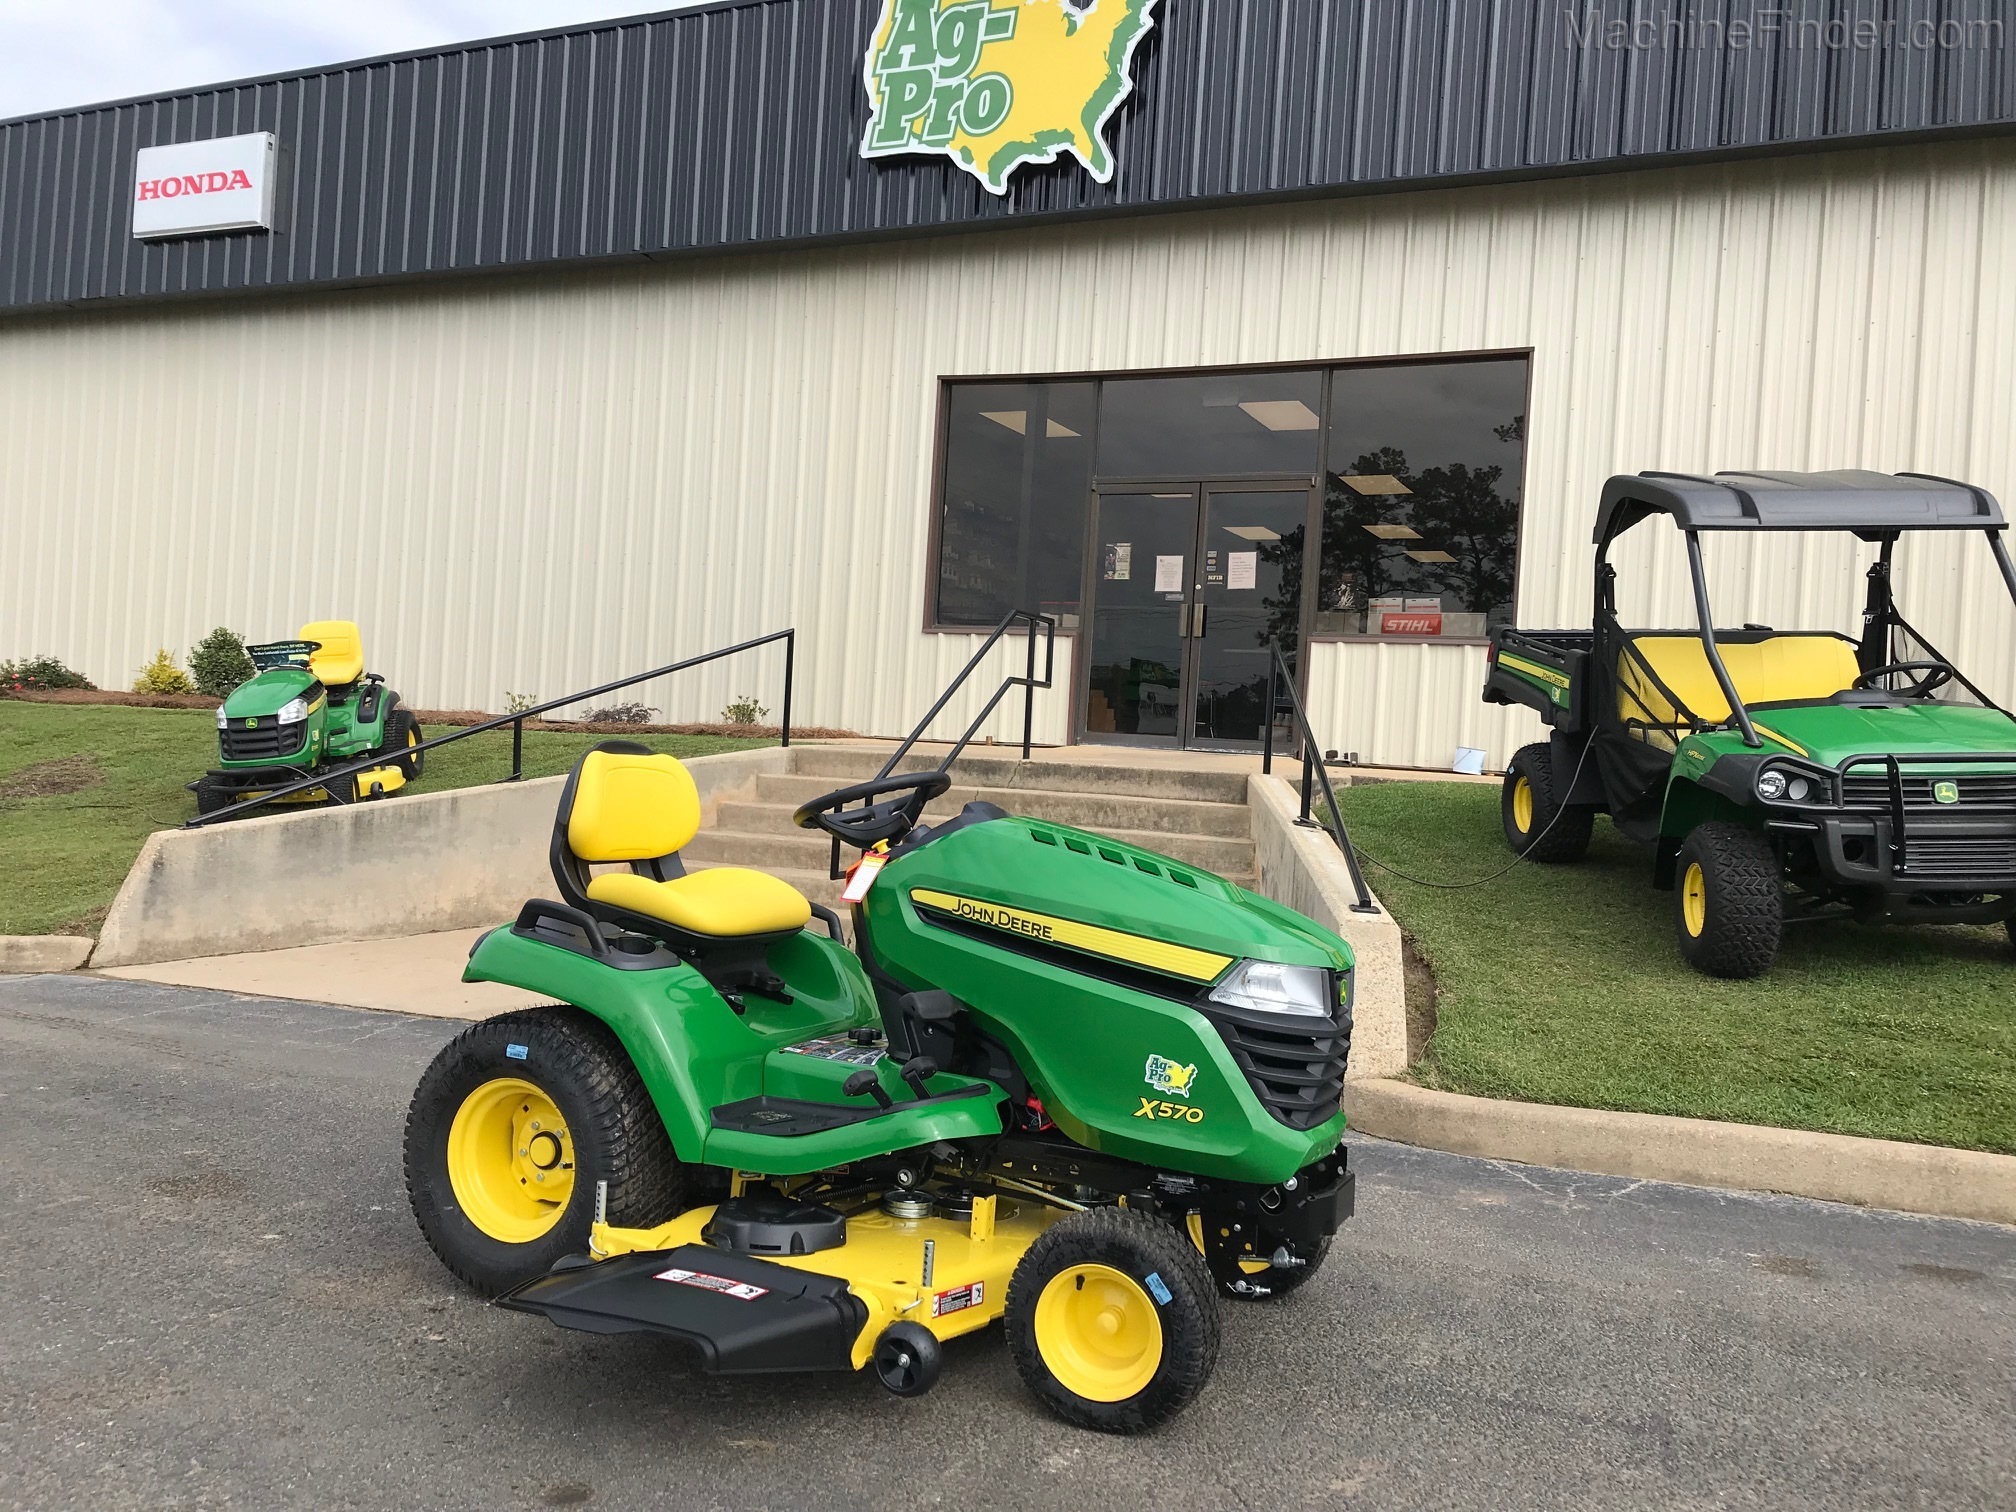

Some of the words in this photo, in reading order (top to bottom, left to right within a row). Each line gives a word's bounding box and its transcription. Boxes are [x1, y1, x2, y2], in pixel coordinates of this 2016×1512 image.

[877, 0, 1014, 80] Ag-
[872, 69, 1011, 147] Pro
[137, 169, 253, 201] HONDA
[1385, 619, 1433, 632] STIHL
[1552, 675, 1565, 686] DEERE
[952, 899, 995, 923] JOHN
[998, 910, 1053, 940] DEERE
[1148, 1068, 1172, 1083] Pro
[1149, 1057, 1173, 1072] Ag-
[1132, 1096, 1205, 1123] X570
